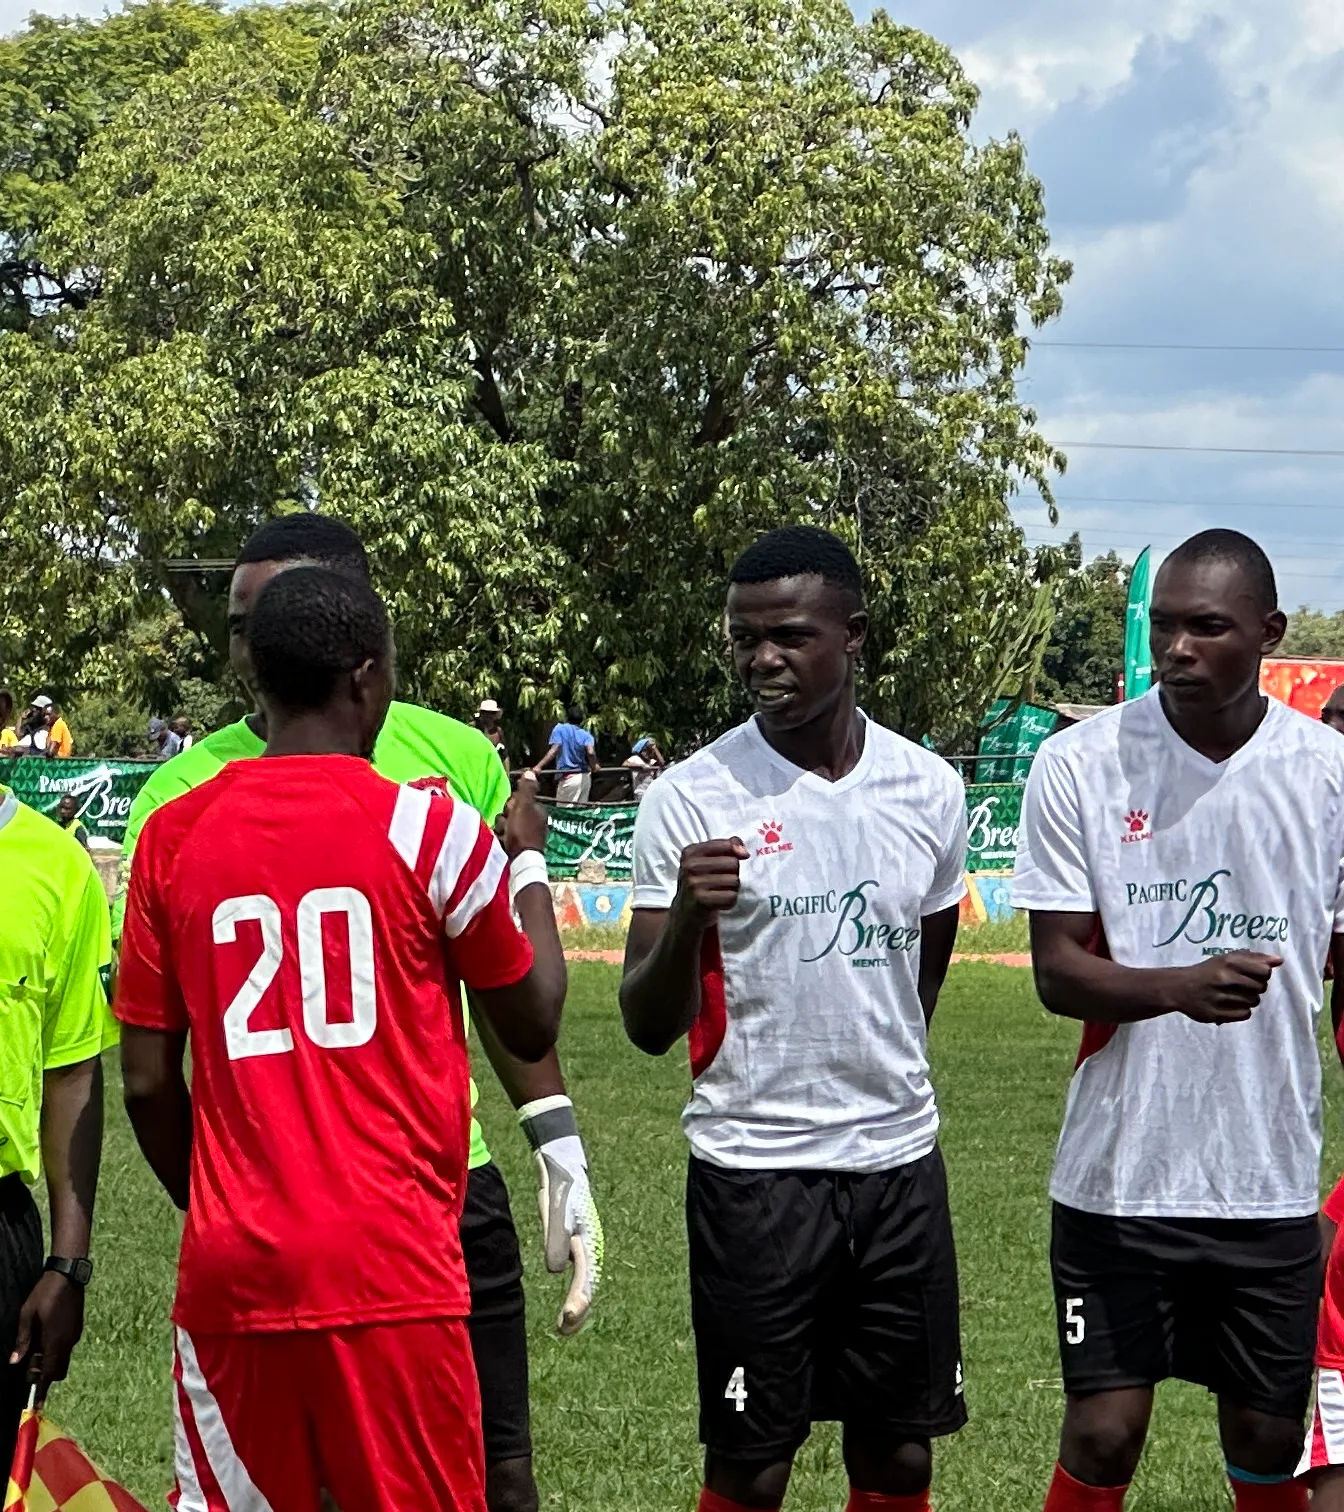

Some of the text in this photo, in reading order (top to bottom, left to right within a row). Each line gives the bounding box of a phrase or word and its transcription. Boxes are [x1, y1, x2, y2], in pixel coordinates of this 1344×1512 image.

[74, 768, 131, 819] Bre
[755, 842, 794, 857] KELME
[769, 879, 921, 963] PACIFIC Breeze
[1126, 869, 1288, 948] PACIFIC Breeze
[212, 886, 377, 1061] 20
[1066, 1298, 1085, 1344] 5
[724, 1367, 748, 1411] 4
